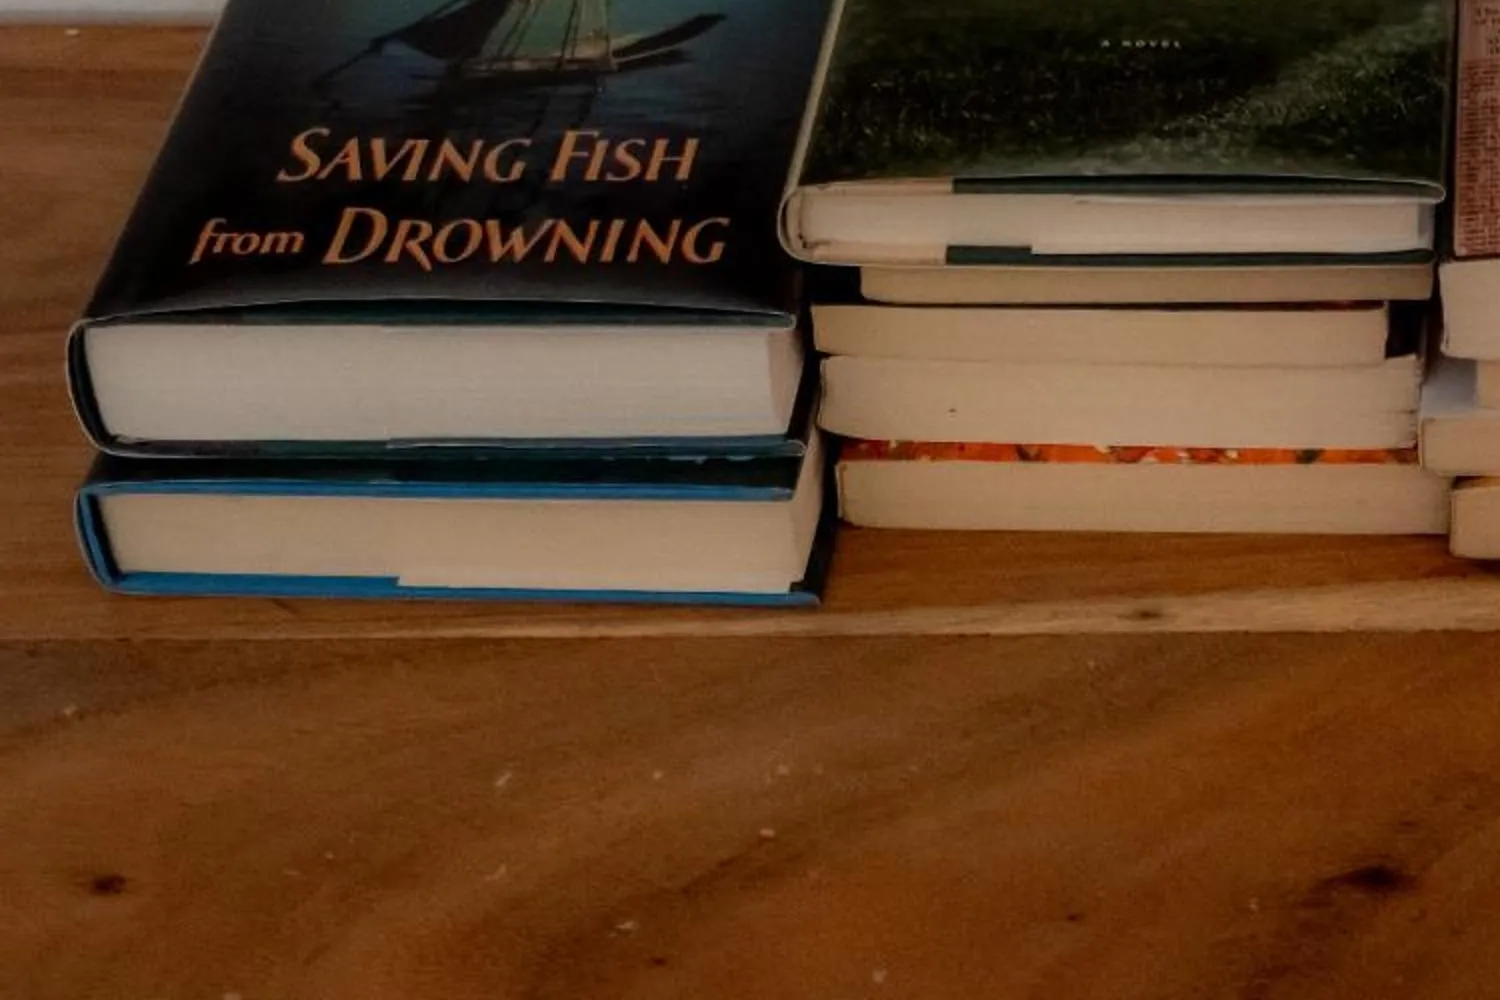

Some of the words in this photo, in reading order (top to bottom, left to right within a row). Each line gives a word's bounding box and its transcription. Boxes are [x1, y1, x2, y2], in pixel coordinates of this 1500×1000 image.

[276, 128, 532, 182] SAVING
[549, 131, 698, 181] FISH
[188, 217, 304, 265] from
[321, 207, 730, 271] DROWNING
